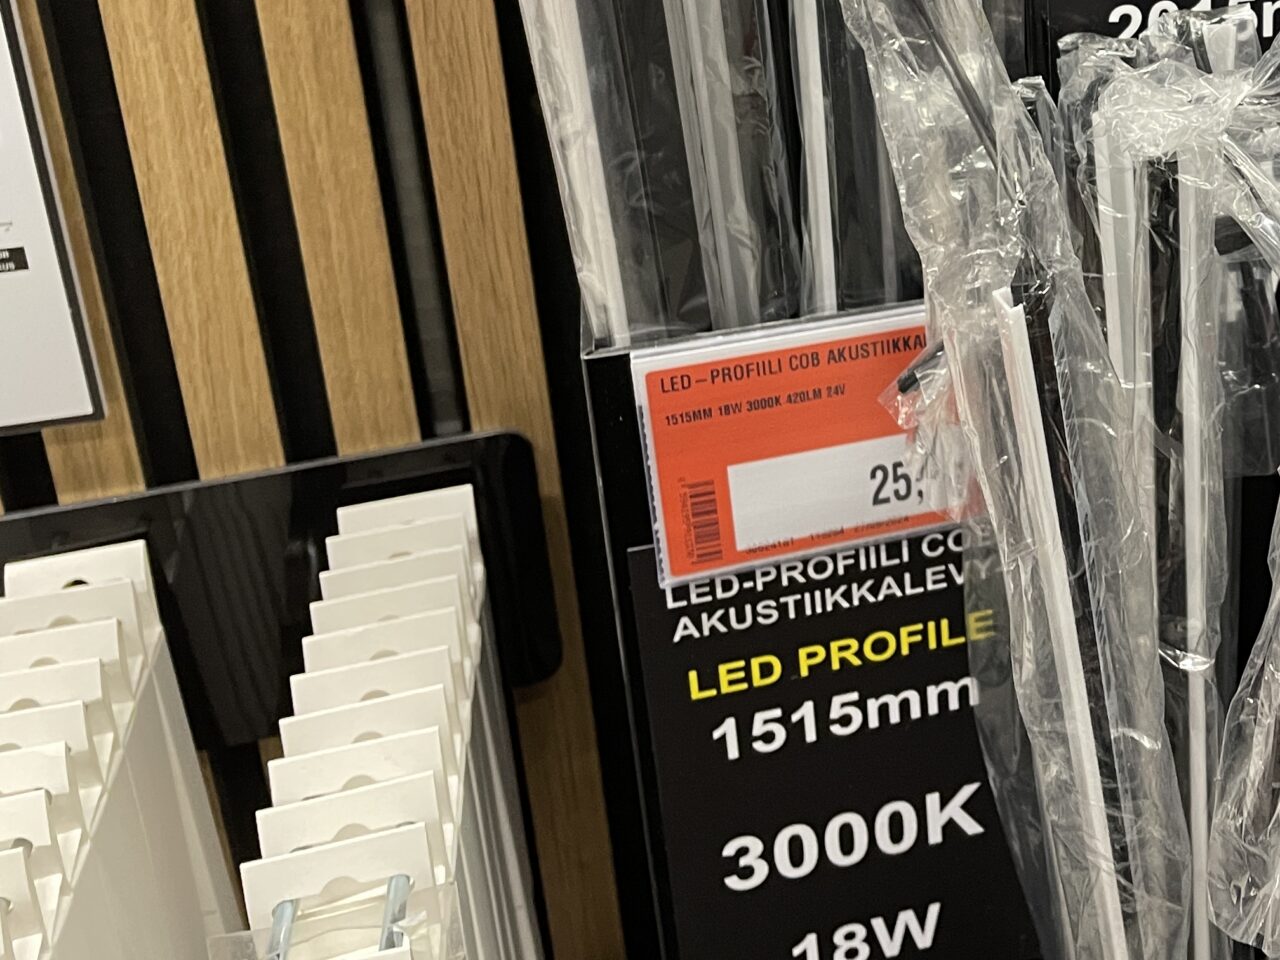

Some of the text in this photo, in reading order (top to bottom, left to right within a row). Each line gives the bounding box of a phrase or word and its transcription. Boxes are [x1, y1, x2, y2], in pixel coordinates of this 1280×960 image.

[788, 351, 821, 373] COB
[665, 384, 846, 426] 1515MM 18W 3000K 420LM 24V
[870, 461, 926, 506] 25,
[665, 540, 909, 610] LED-PROFIILI
[688, 609, 996, 701] LED PROFILE
[712, 676, 980, 761] 1515mm
[721, 782, 985, 892] 3000K
[792, 901, 942, 960] 18W
